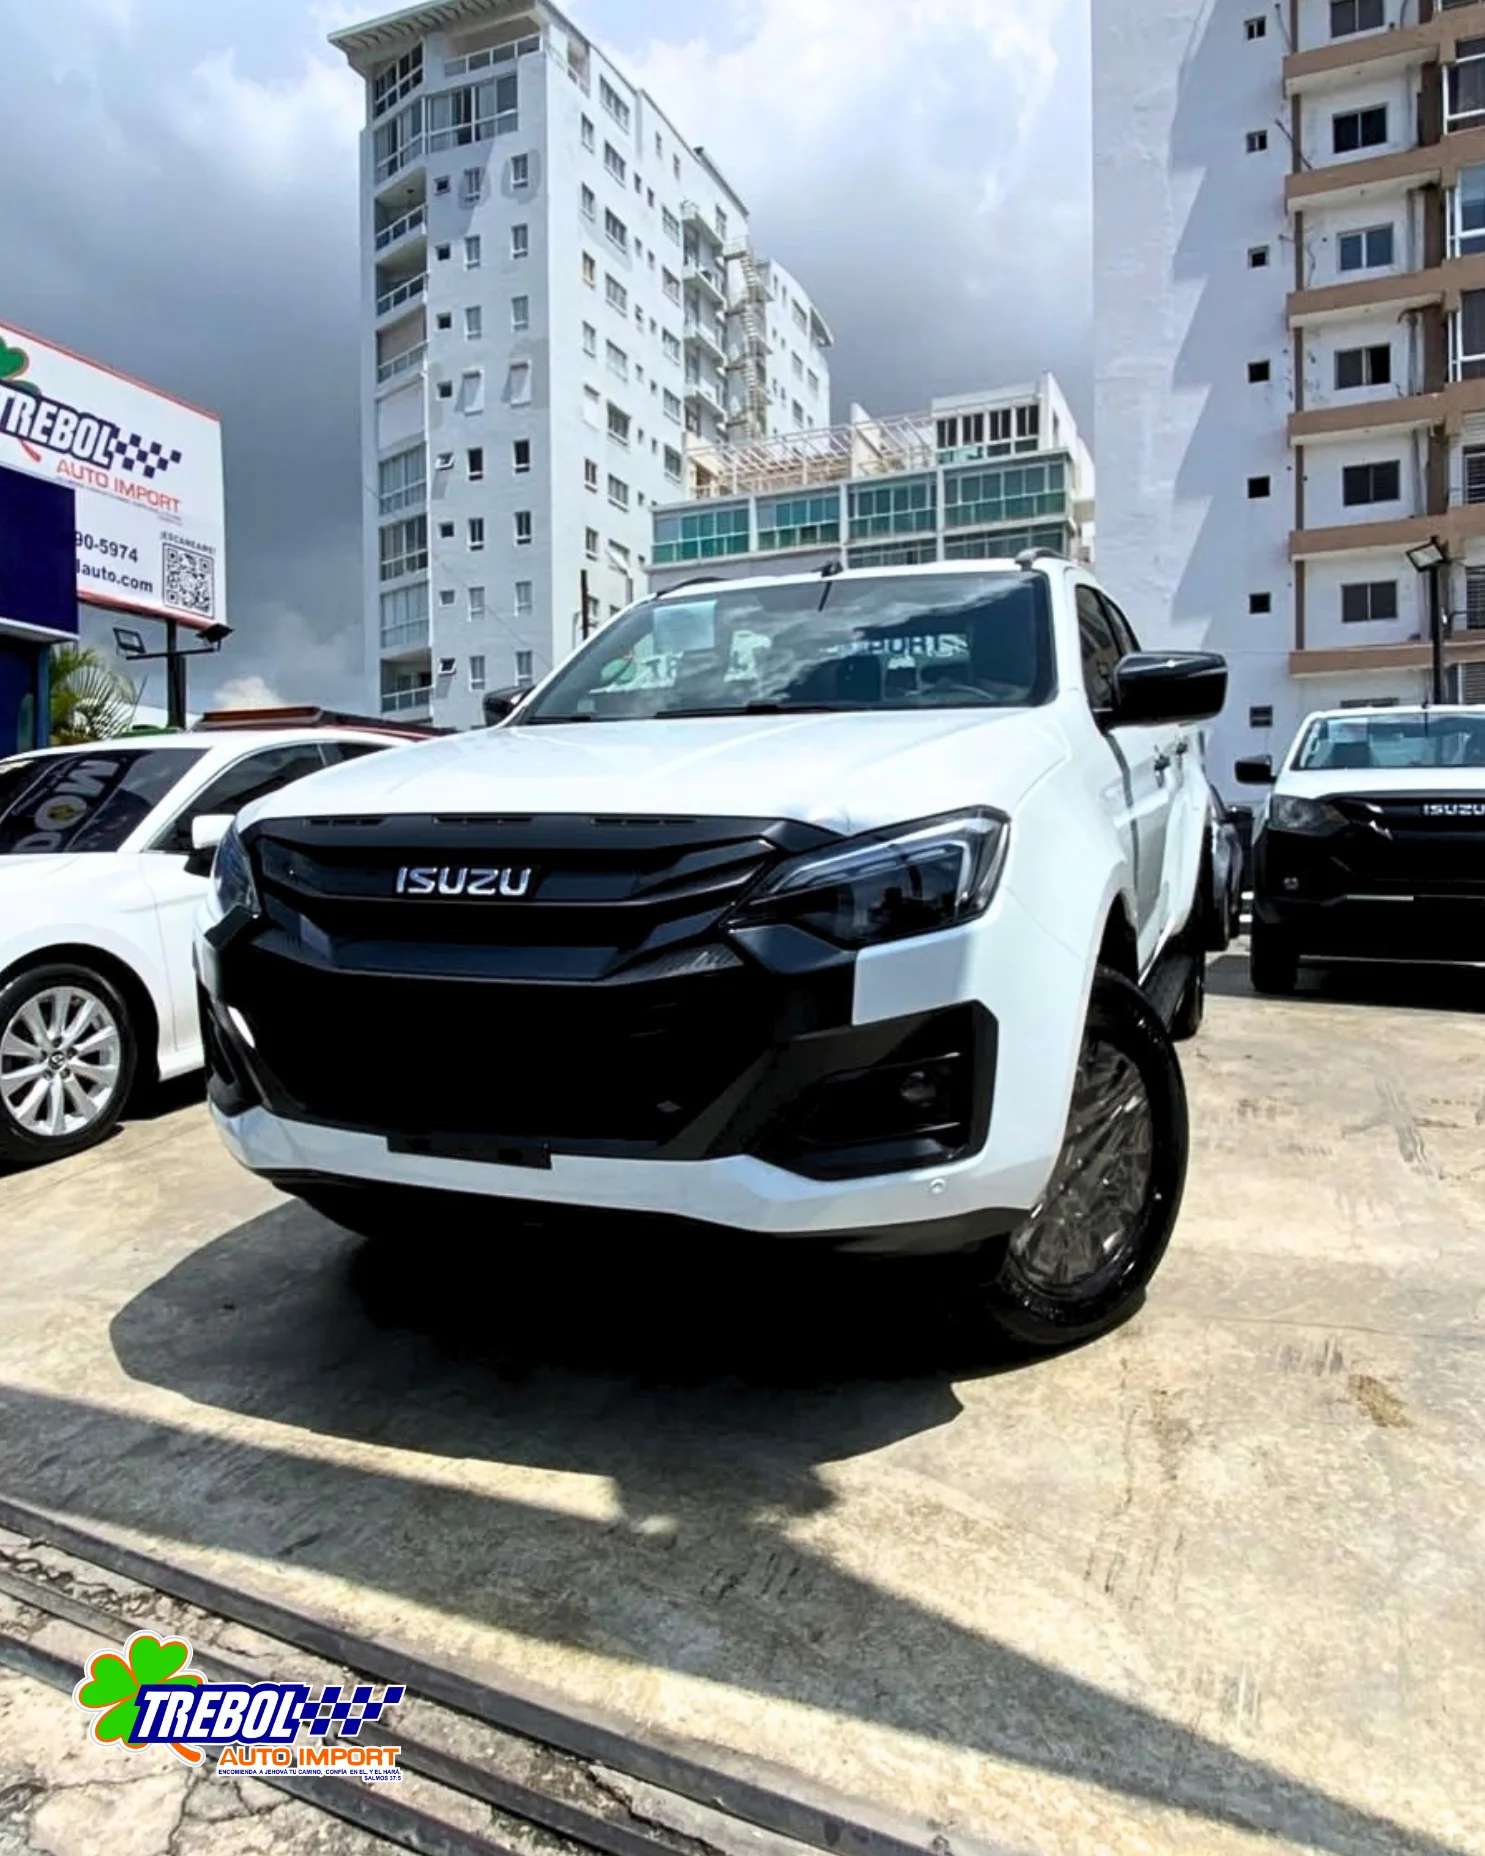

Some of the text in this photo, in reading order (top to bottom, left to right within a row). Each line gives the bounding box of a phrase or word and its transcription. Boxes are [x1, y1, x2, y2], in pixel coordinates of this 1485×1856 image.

[56, 459, 108, 489] AUTO
[114, 477, 181, 513] IMPORT
[1423, 804, 1485, 816] ISUZU
[396, 867, 532, 896] ISUZU
